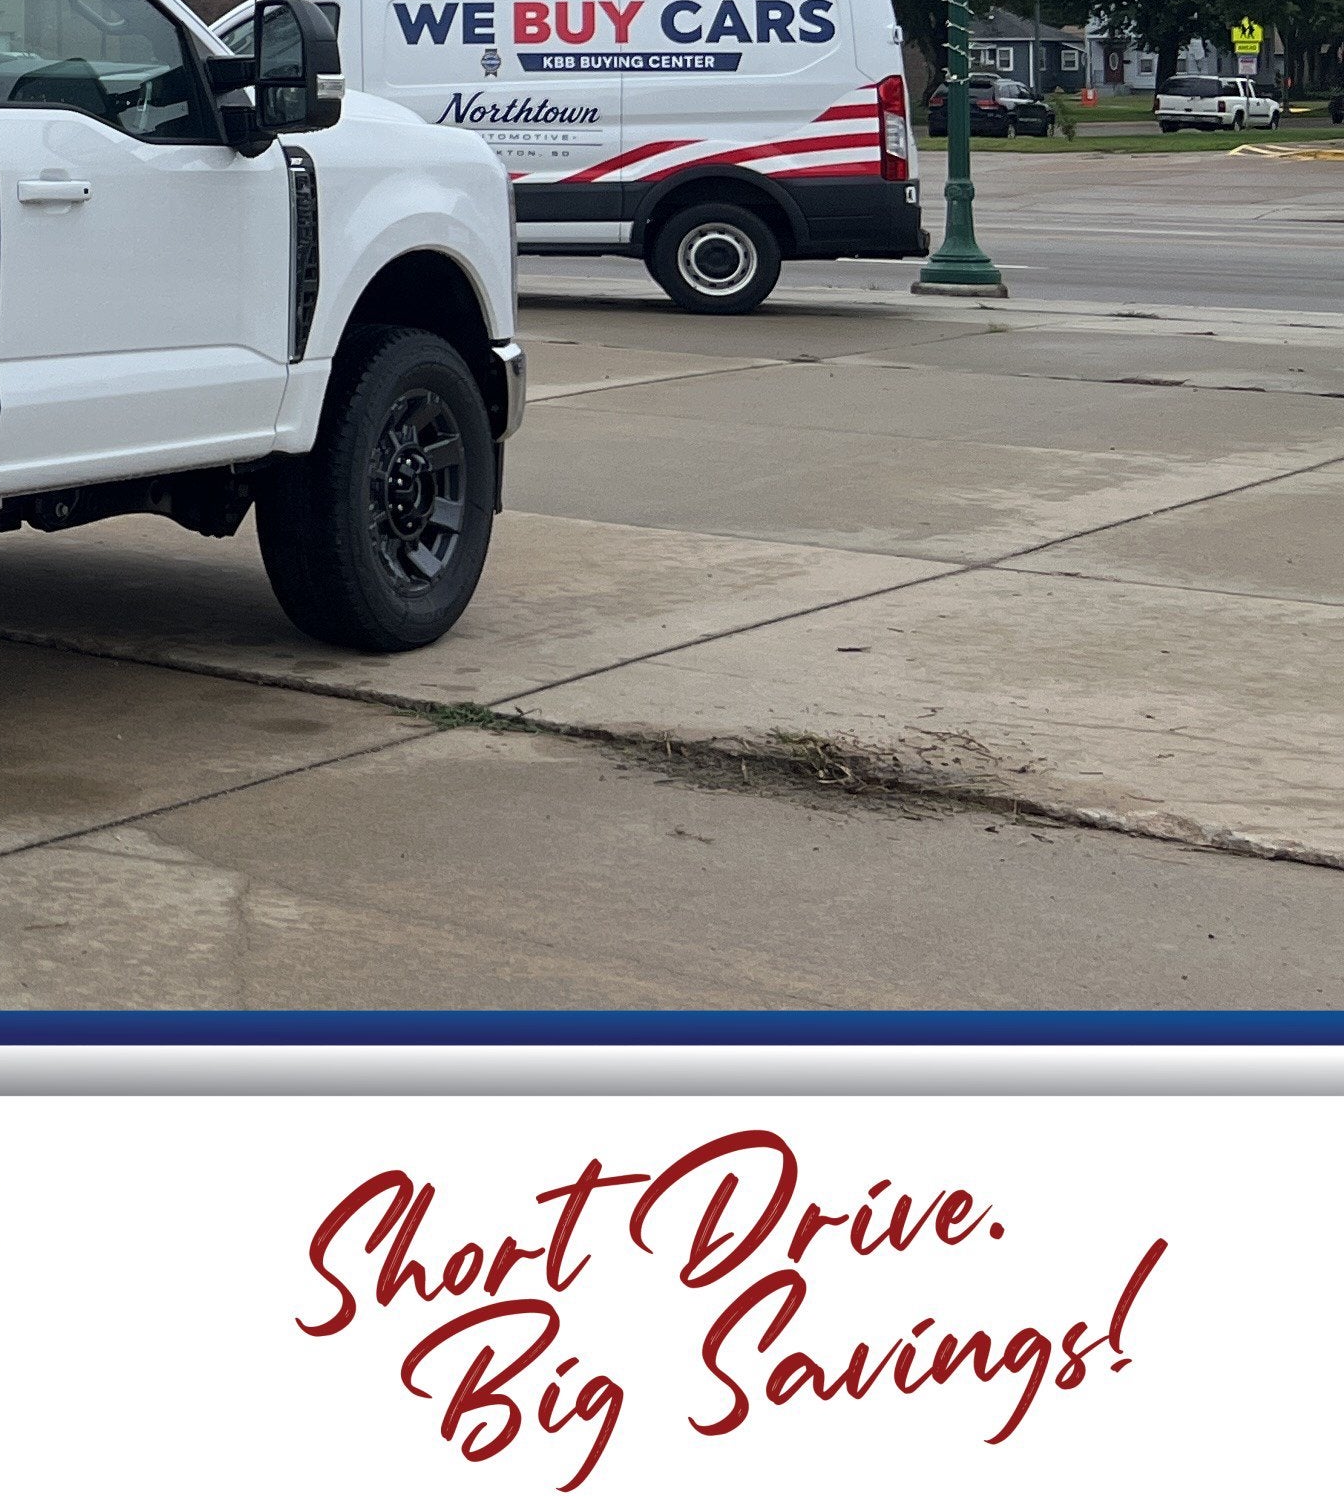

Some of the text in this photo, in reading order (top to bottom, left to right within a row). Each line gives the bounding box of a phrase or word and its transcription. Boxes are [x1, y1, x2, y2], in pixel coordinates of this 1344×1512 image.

[393, 0, 836, 45] WE BUY CARS
[542, 56, 715, 69] KBB BUYING CENTER
[435, 90, 601, 125] Northtown
